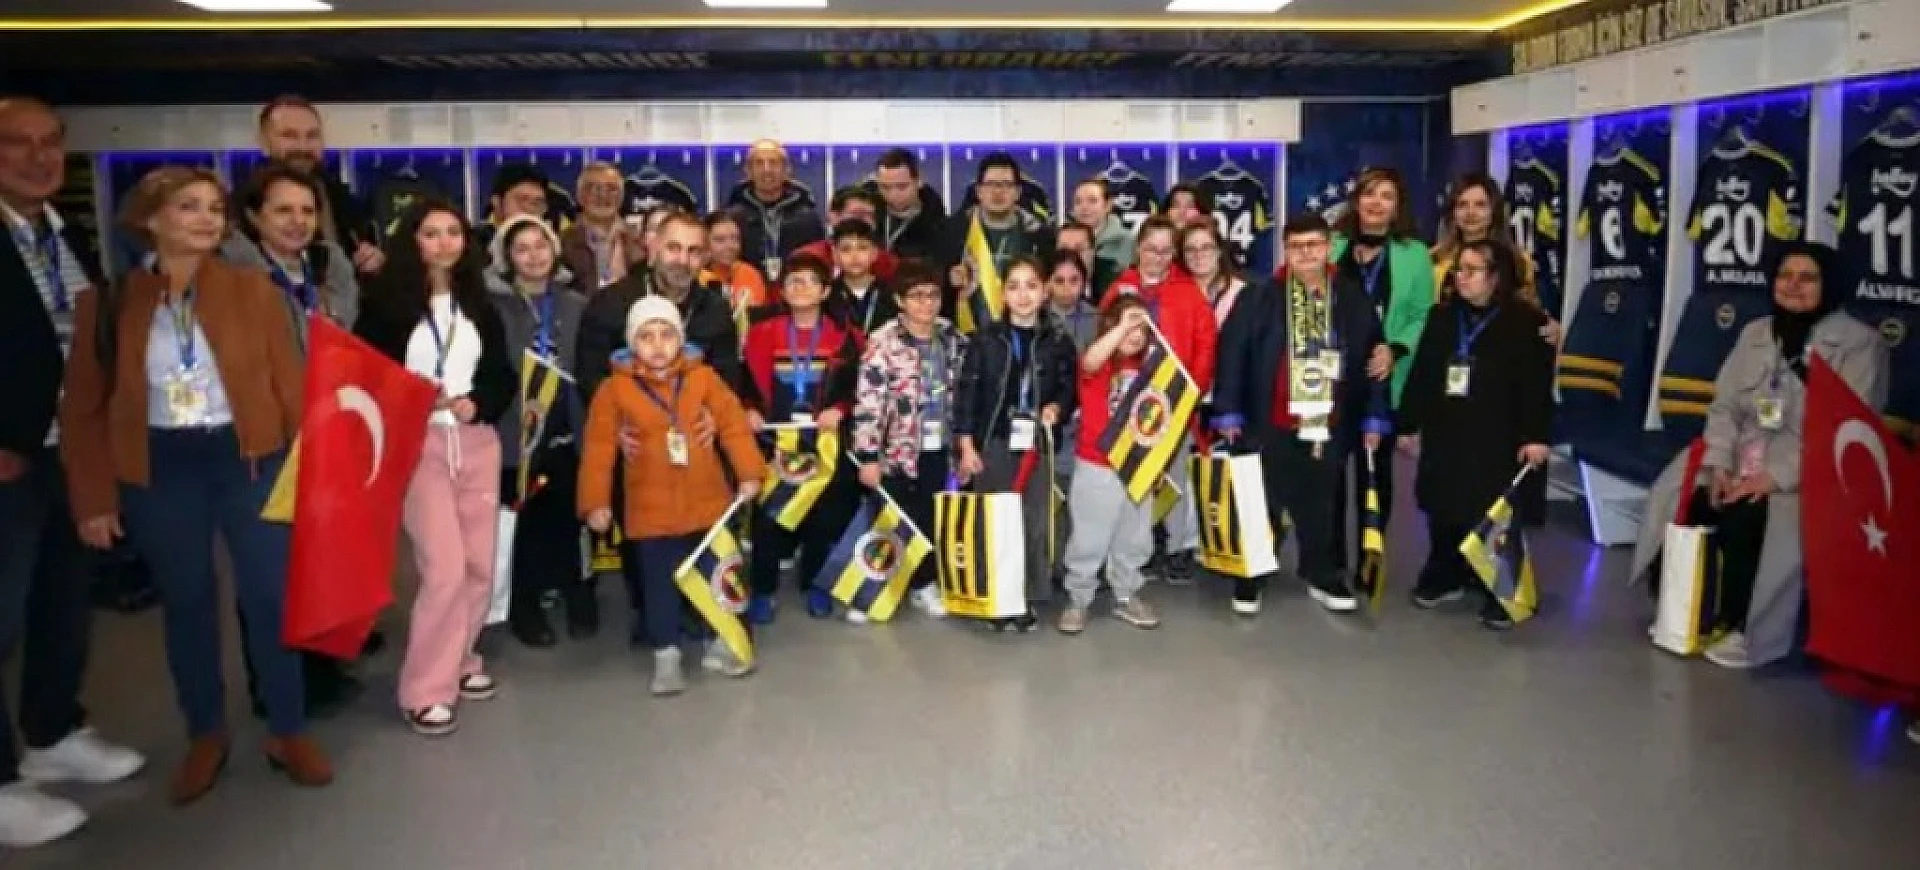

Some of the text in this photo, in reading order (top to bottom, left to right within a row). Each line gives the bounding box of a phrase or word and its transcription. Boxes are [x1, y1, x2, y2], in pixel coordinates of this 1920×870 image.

[1601, 207, 1626, 260] 6
[1701, 203, 1765, 267] 20
[1857, 202, 1914, 279] 11
